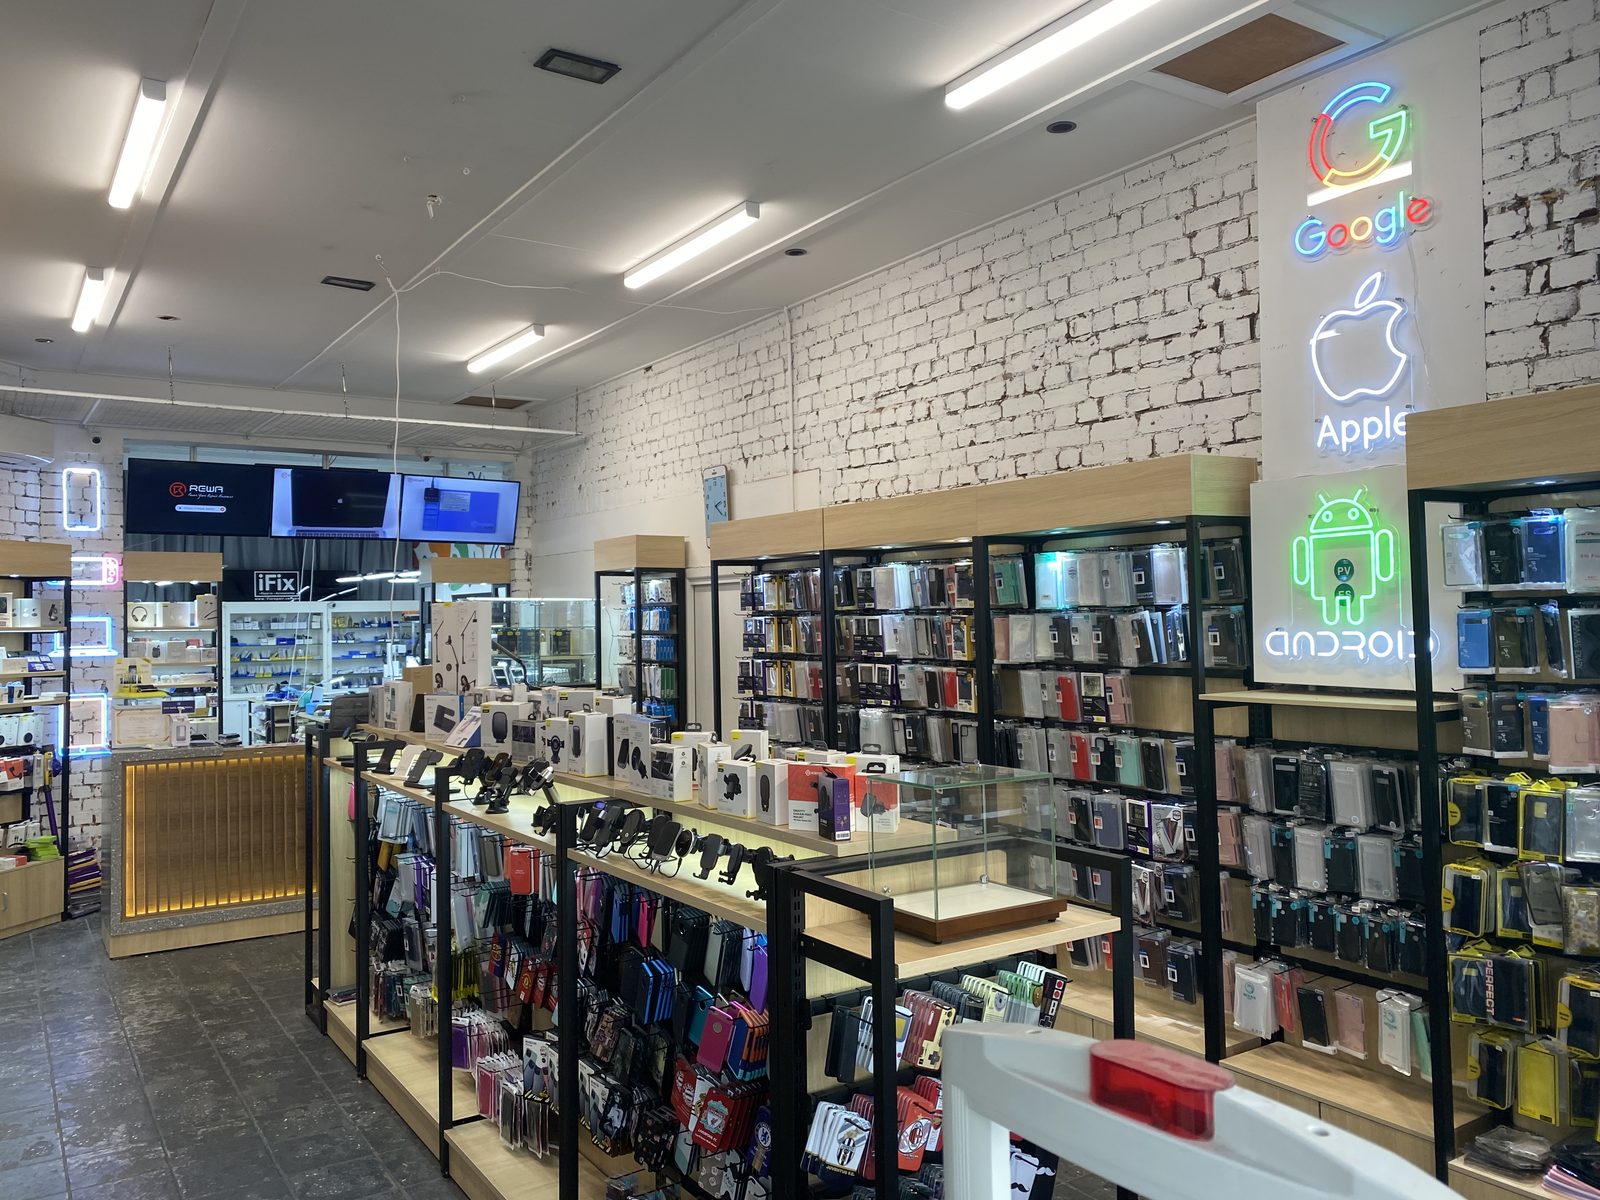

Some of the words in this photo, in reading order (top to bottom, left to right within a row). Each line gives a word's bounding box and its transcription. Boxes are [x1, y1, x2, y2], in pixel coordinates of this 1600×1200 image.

[1294, 190, 1433, 257] Google
[189, 484, 224, 493] REWA
[1337, 566, 1351, 576] PV
[258, 573, 296, 592] iFix
[1485, 960, 1495, 1016] PERFECT
